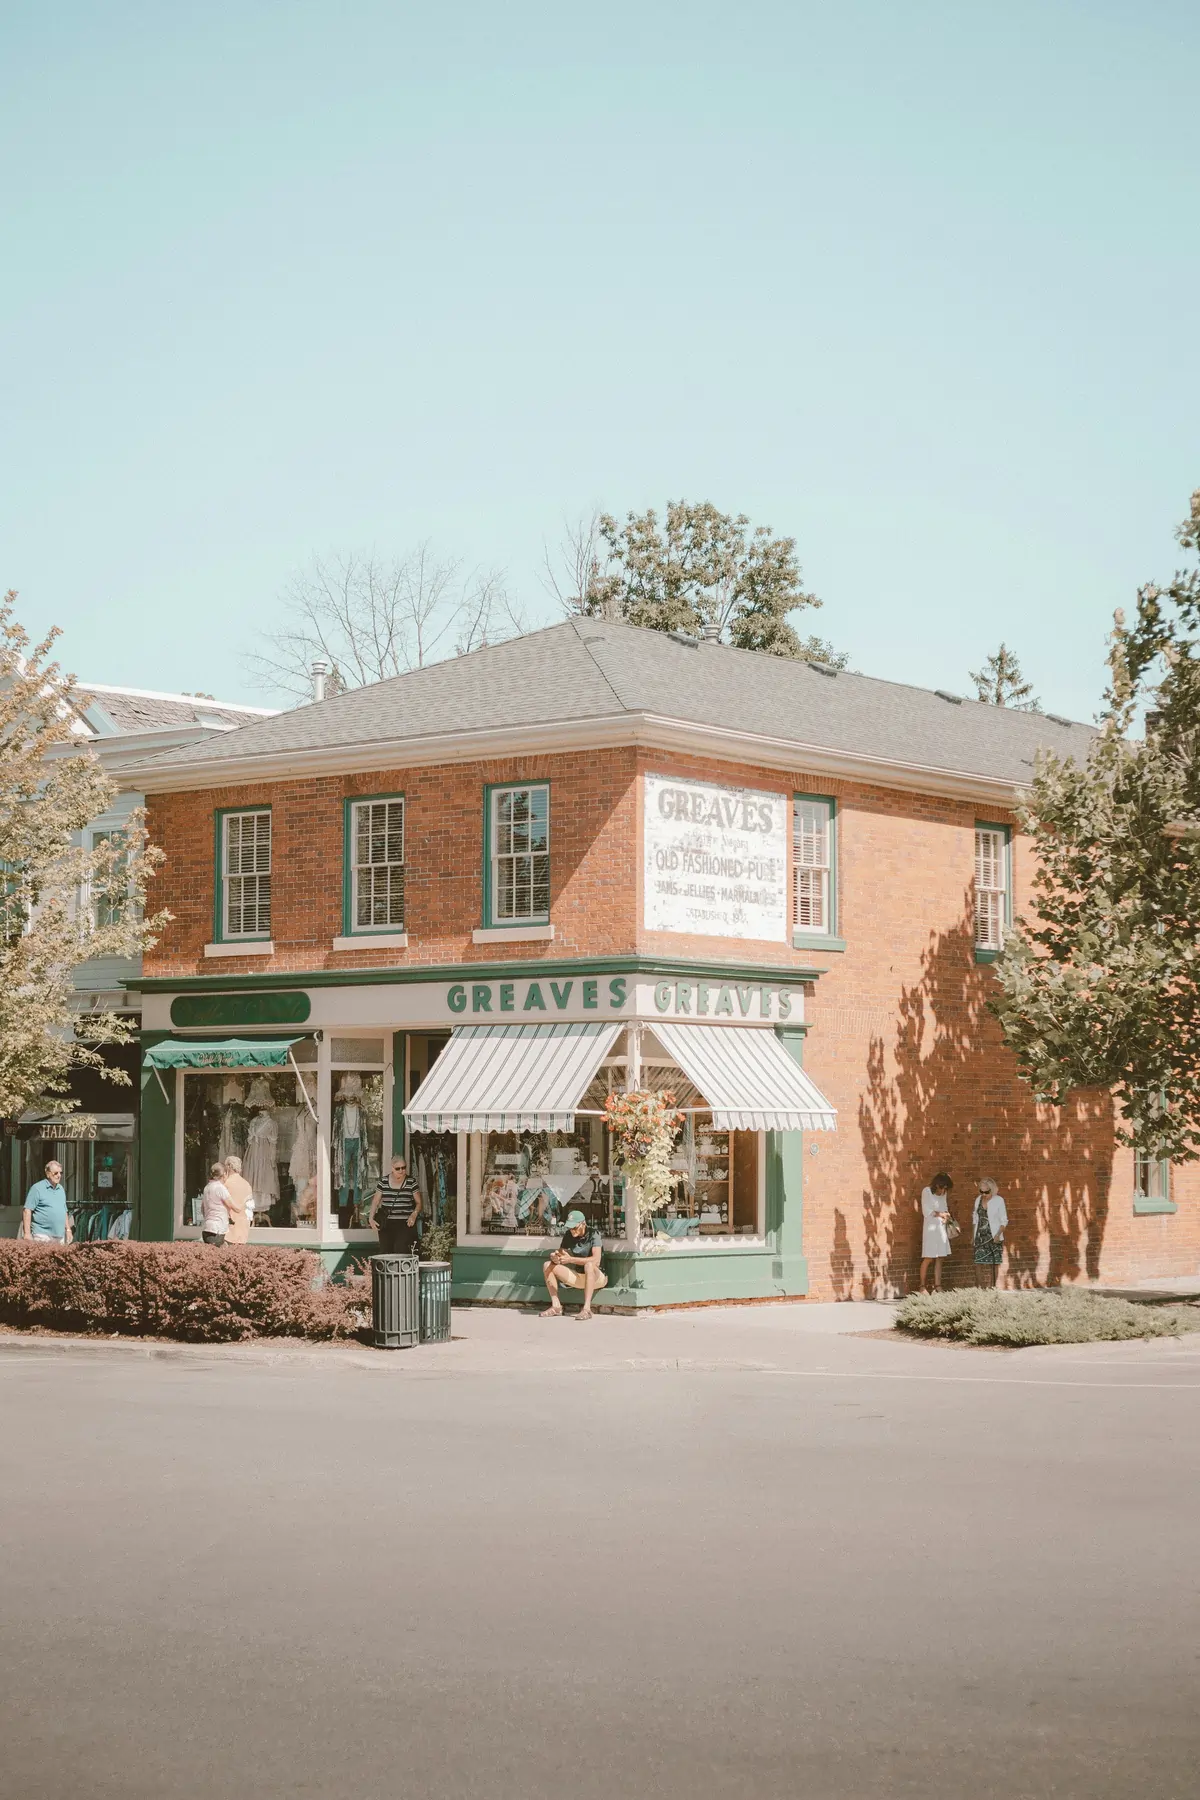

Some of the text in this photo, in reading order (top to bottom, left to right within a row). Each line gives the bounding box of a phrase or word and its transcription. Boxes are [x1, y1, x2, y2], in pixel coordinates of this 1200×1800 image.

[658, 788, 773, 834] GREAVES
[655, 850, 679, 871] OLD
[683, 851, 743, 878] FASHIONED
[655, 880, 678, 896] JAMS
[684, 883, 716, 900] JELLIES
[447, 978, 627, 1013] GREAVES
[654, 980, 793, 1018] GREAVES
